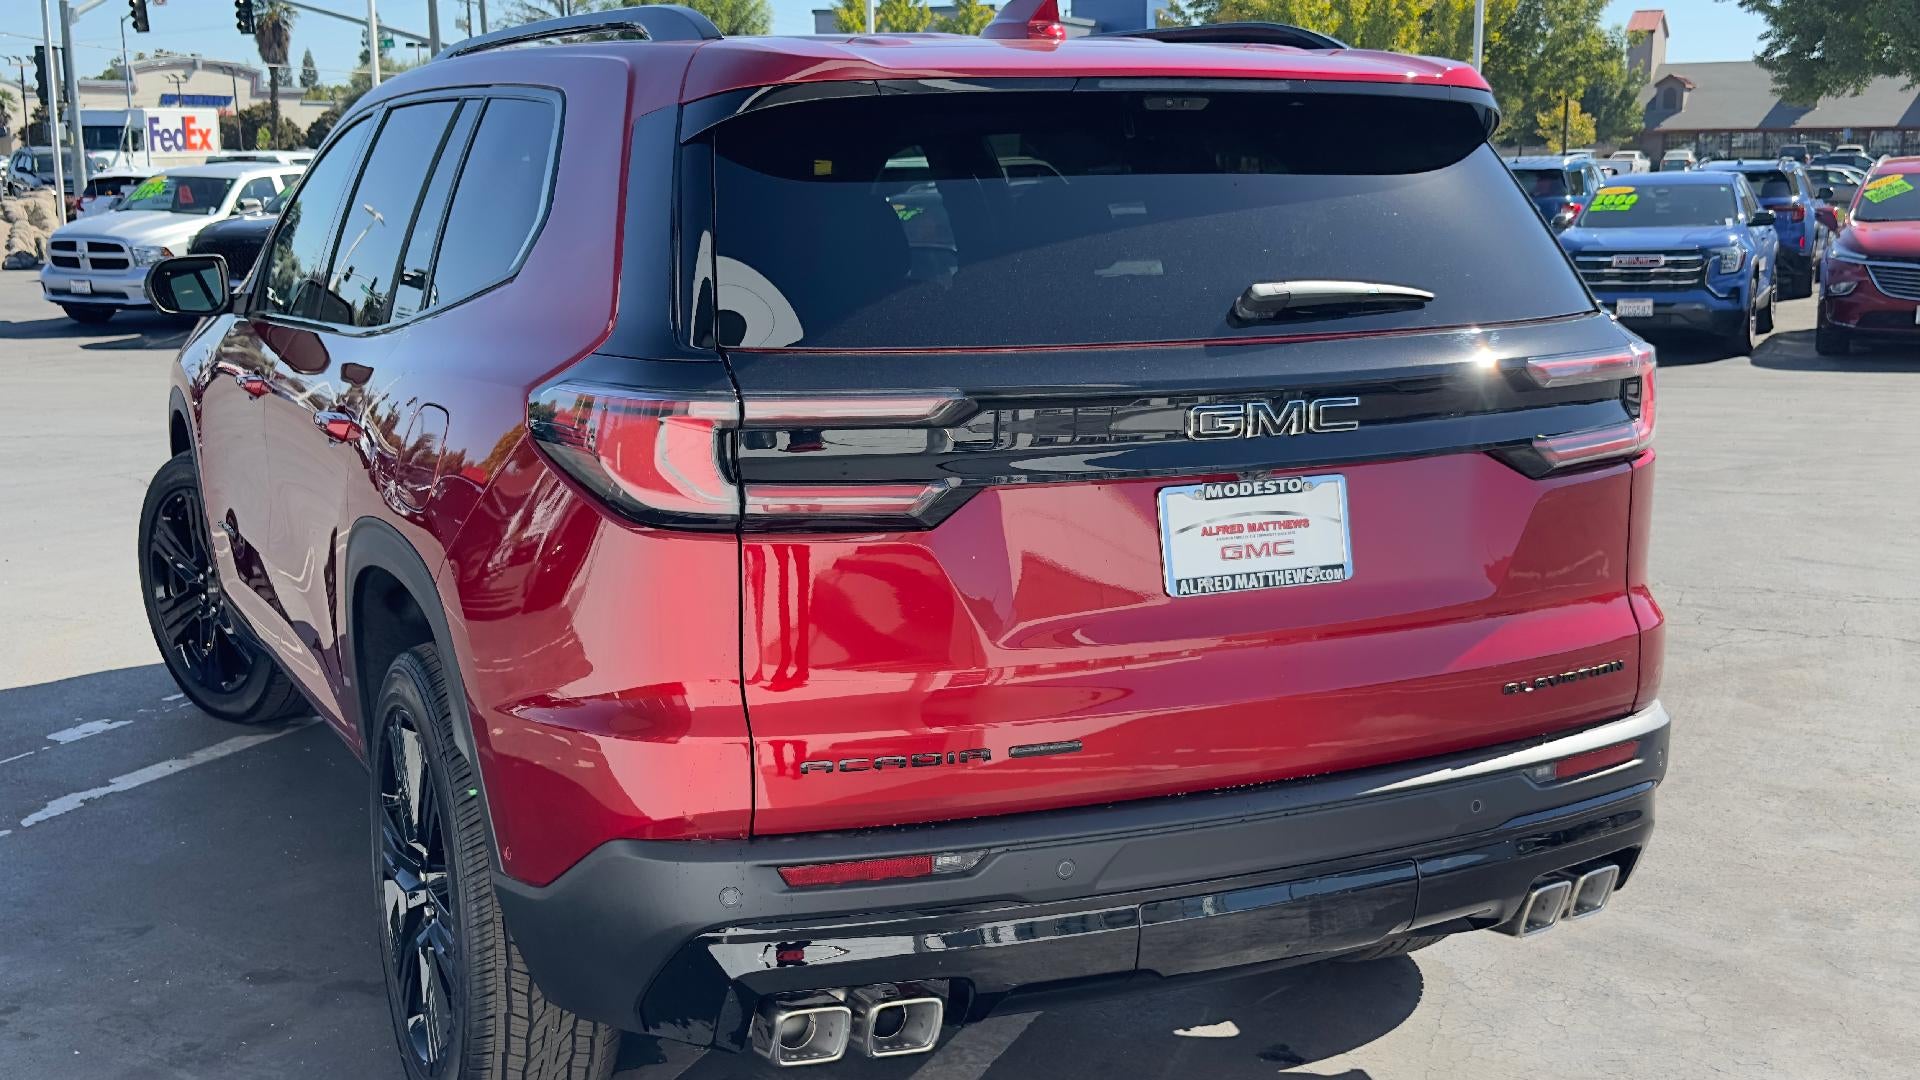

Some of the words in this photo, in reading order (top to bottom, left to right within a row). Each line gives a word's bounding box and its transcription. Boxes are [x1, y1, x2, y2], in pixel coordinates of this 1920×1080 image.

[148, 116, 212, 152] FedEx
[1184, 396, 1360, 440] GMC
[1205, 479, 1302, 499] MODESTO
[1201, 523, 1245, 537] ALFRED
[1247, 518, 1310, 532] MATTHEWS
[1221, 539, 1295, 561] GMC
[1503, 659, 1625, 695] ELEVATION
[800, 748, 992, 774] ACADIA
